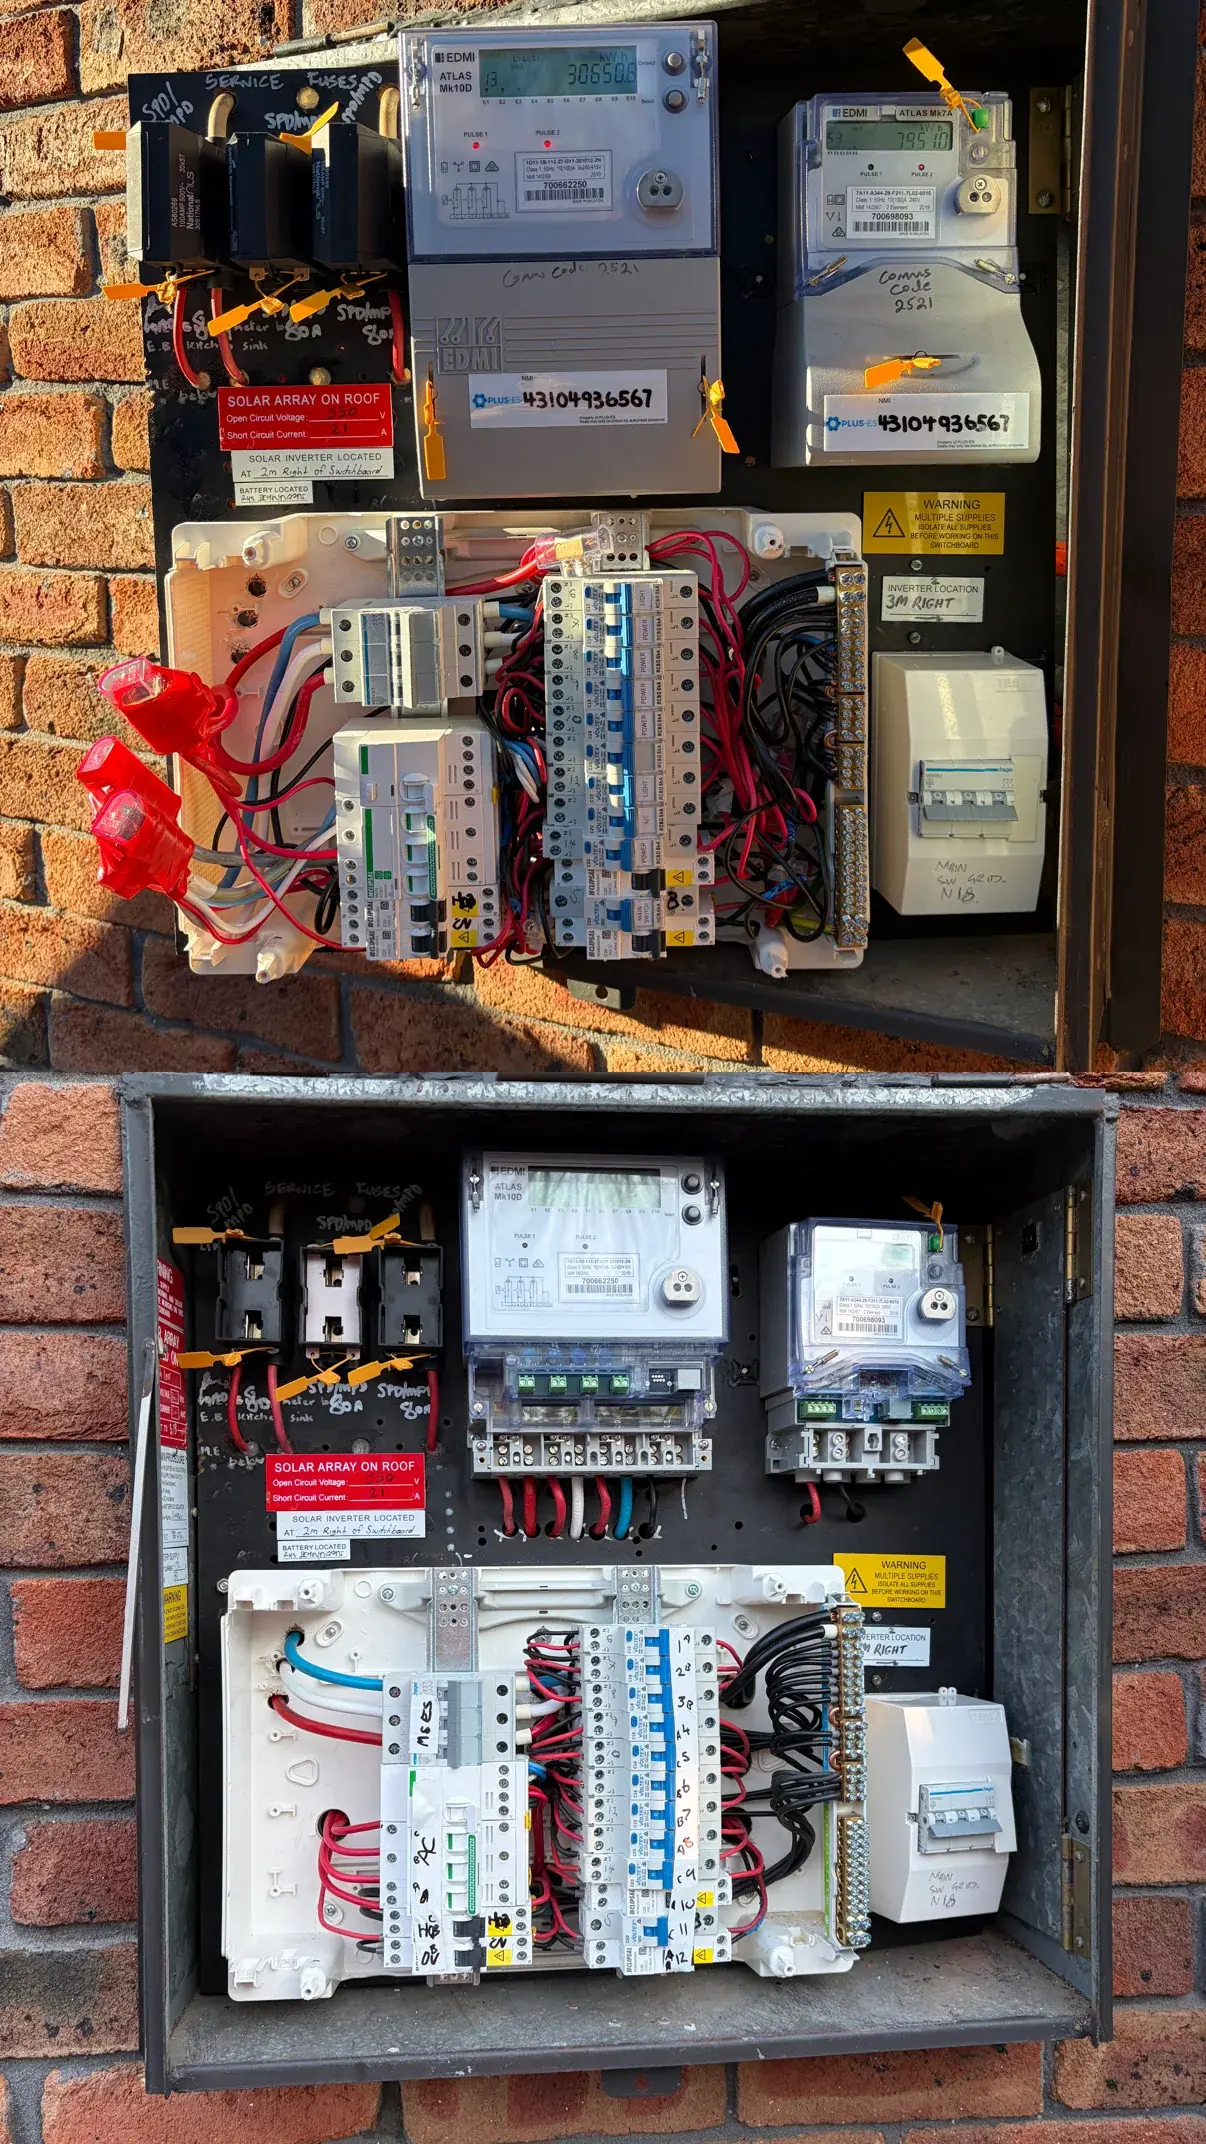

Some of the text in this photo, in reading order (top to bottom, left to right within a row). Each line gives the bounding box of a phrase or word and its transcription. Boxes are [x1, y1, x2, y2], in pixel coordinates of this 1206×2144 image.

[446, 52, 475, 63] EDMI
[205, 71, 357, 90] SERVICE FUSES
[440, 72, 472, 81] ATLAS
[440, 83, 472, 93] Mk10D
[842, 108, 868, 117] EDMI
[900, 109, 953, 117] ATLAS Mk7A
[543, 180, 587, 190] 700662250
[895, 297, 933, 314] 2521
[445, 348, 499, 371] EDMI
[227, 393, 380, 408] SOLAR ARRAY ON ROOF
[523, 388, 653, 410] 43104936567
[226, 414, 247, 424] Open
[250, 413, 274, 423] Circuit
[842, 419, 878, 427] PLUS-ES
[878, 414, 1010, 433] 43104936567
[227, 431, 248, 440] Short
[250, 431, 274, 440] Circuit
[380, 428, 387, 436] A
[248, 452, 382, 463] SOLAR INVERTER LOCATED
[282, 466, 309, 478] Right
[314, 464, 326, 476] of
[329, 464, 382, 476] Switchboard
[239, 485, 309, 494] BATTERY LOCATED
[924, 500, 981, 510] WARNING
[914, 513, 996, 522] MULTIPLE SUPPLIES
[910, 532, 938, 540] BEFORE
[938, 532, 971, 540] WORKING
[888, 584, 979, 594] INVERTER LOCATION
[912, 596, 955, 610] RIGHT
[501, 1167, 525, 1176] EDMI
[264, 1181, 336, 1196] SERVICE
[494, 1183, 522, 1191] ATLAS
[494, 1192, 522, 1201] Mk10D
[275, 1461, 415, 1472] SOLAR ARRAY ON ROOF
[273, 1479, 292, 1487] Open
[294, 1478, 317, 1486] Circuit
[273, 1494, 292, 1502] Short
[292, 1515, 322, 1523] SOLAR
[374, 1514, 415, 1522] LOCATED
[323, 1525, 347, 1536] Right
[352, 1524, 363, 1534] of
[366, 1524, 416, 1534] Switchboard
[881, 1561, 927, 1570] WARNING
[874, 1572, 939, 1581] MULTIPLE SUPPLIES
[891, 1634, 926, 1642] LOCATION
